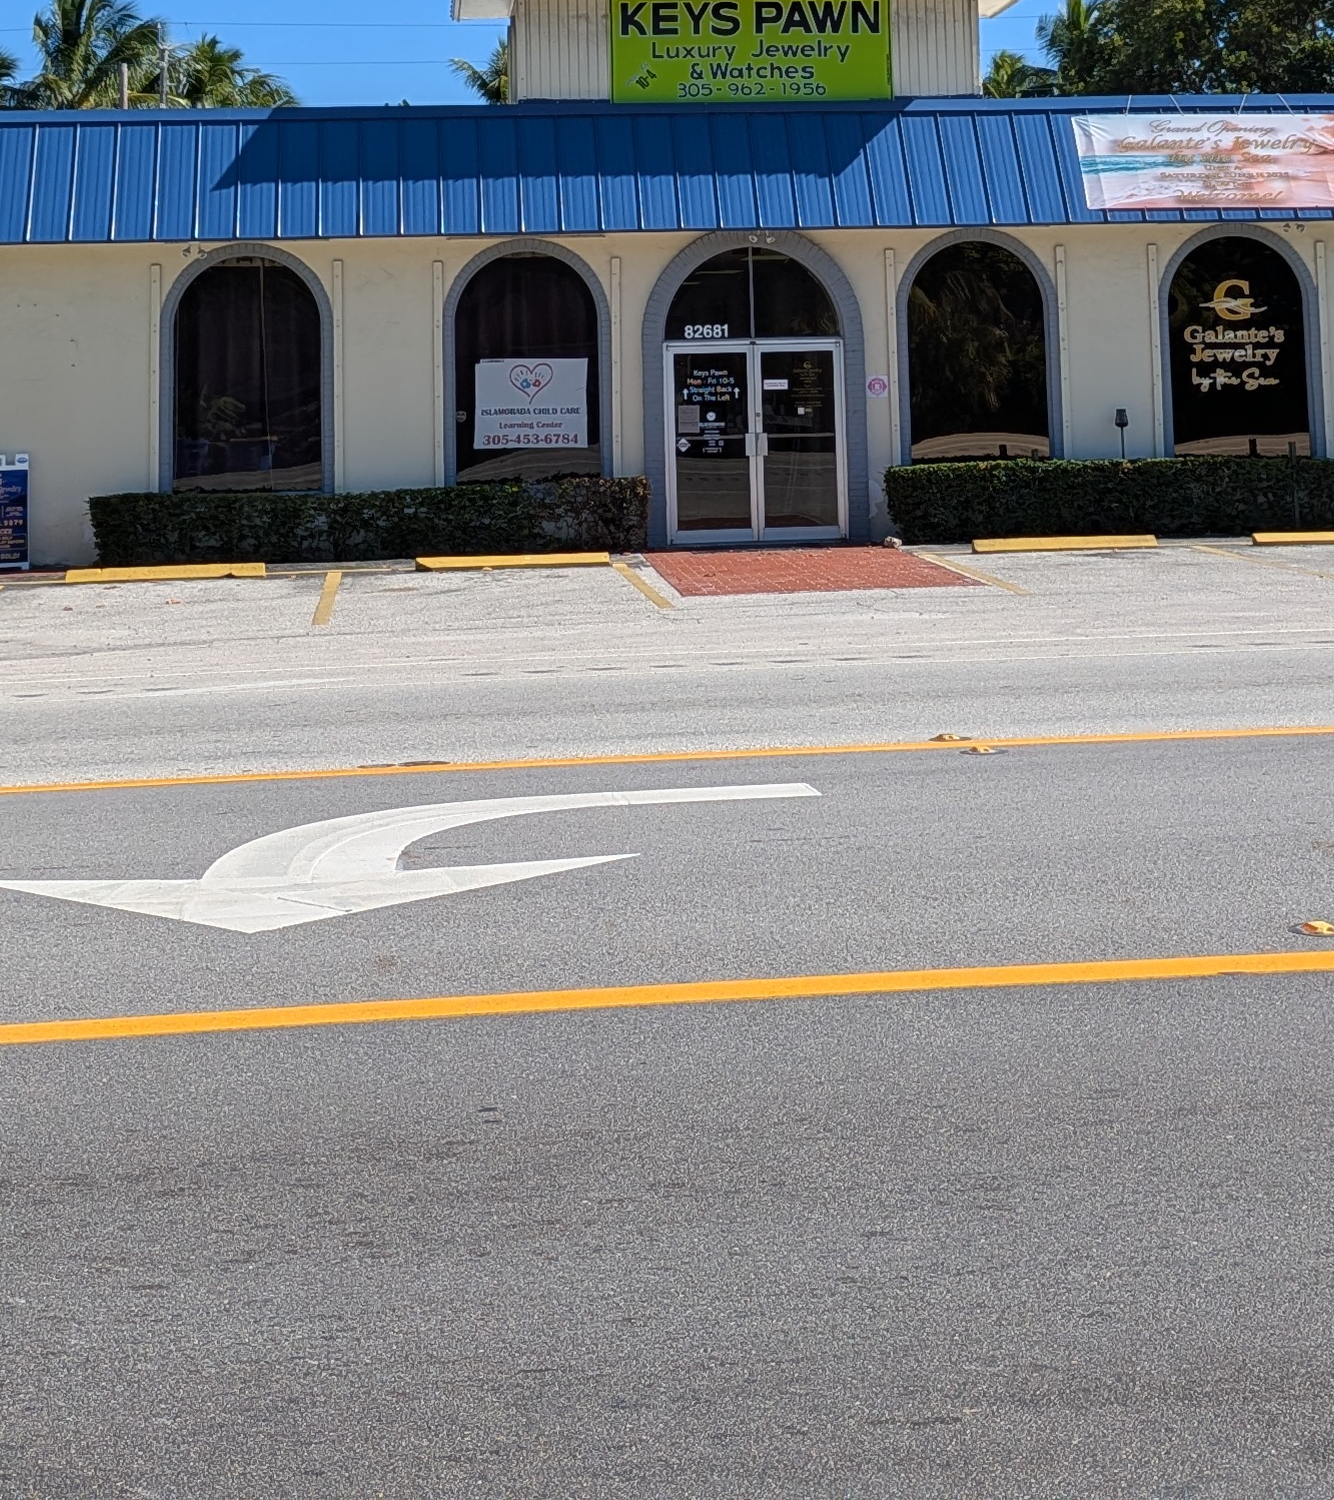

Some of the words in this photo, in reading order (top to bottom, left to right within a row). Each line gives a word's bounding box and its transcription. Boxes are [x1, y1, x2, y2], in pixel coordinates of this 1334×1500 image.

[620, 1, 741, 36] KEYS
[754, 0, 880, 34] PAWN
[652, 41, 736, 61] Luxury
[751, 39, 850, 63] Jewelry
[690, 62, 705, 80] &
[709, 62, 815, 80] Watches
[677, 82, 827, 98] 305-962-1956
[1149, 119, 1207, 134] Grand
[1207, 120, 1276, 137] Opening
[1117, 135, 1223, 152] Galante's
[1232, 134, 1317, 153] Jewelry
[1173, 189, 1283, 201] Welcome!
[684, 324, 729, 339] 82681
[1183, 325, 1285, 343] Galante's
[1190, 344, 1280, 365] Jewelry
[693, 369, 708, 377] Keys
[1191, 367, 1213, 392] by
[1210, 368, 1240, 390] the
[1242, 367, 1279, 391] Sea
[689, 386, 715, 394] Straight
[481, 407, 531, 416] ISLAMORADA
[533, 406, 557, 415] CHILD
[560, 407, 581, 415] CARE
[499, 422, 534, 430] Learning
[536, 421, 563, 429] Center
[482, 433, 579, 445] 305-453-6784
